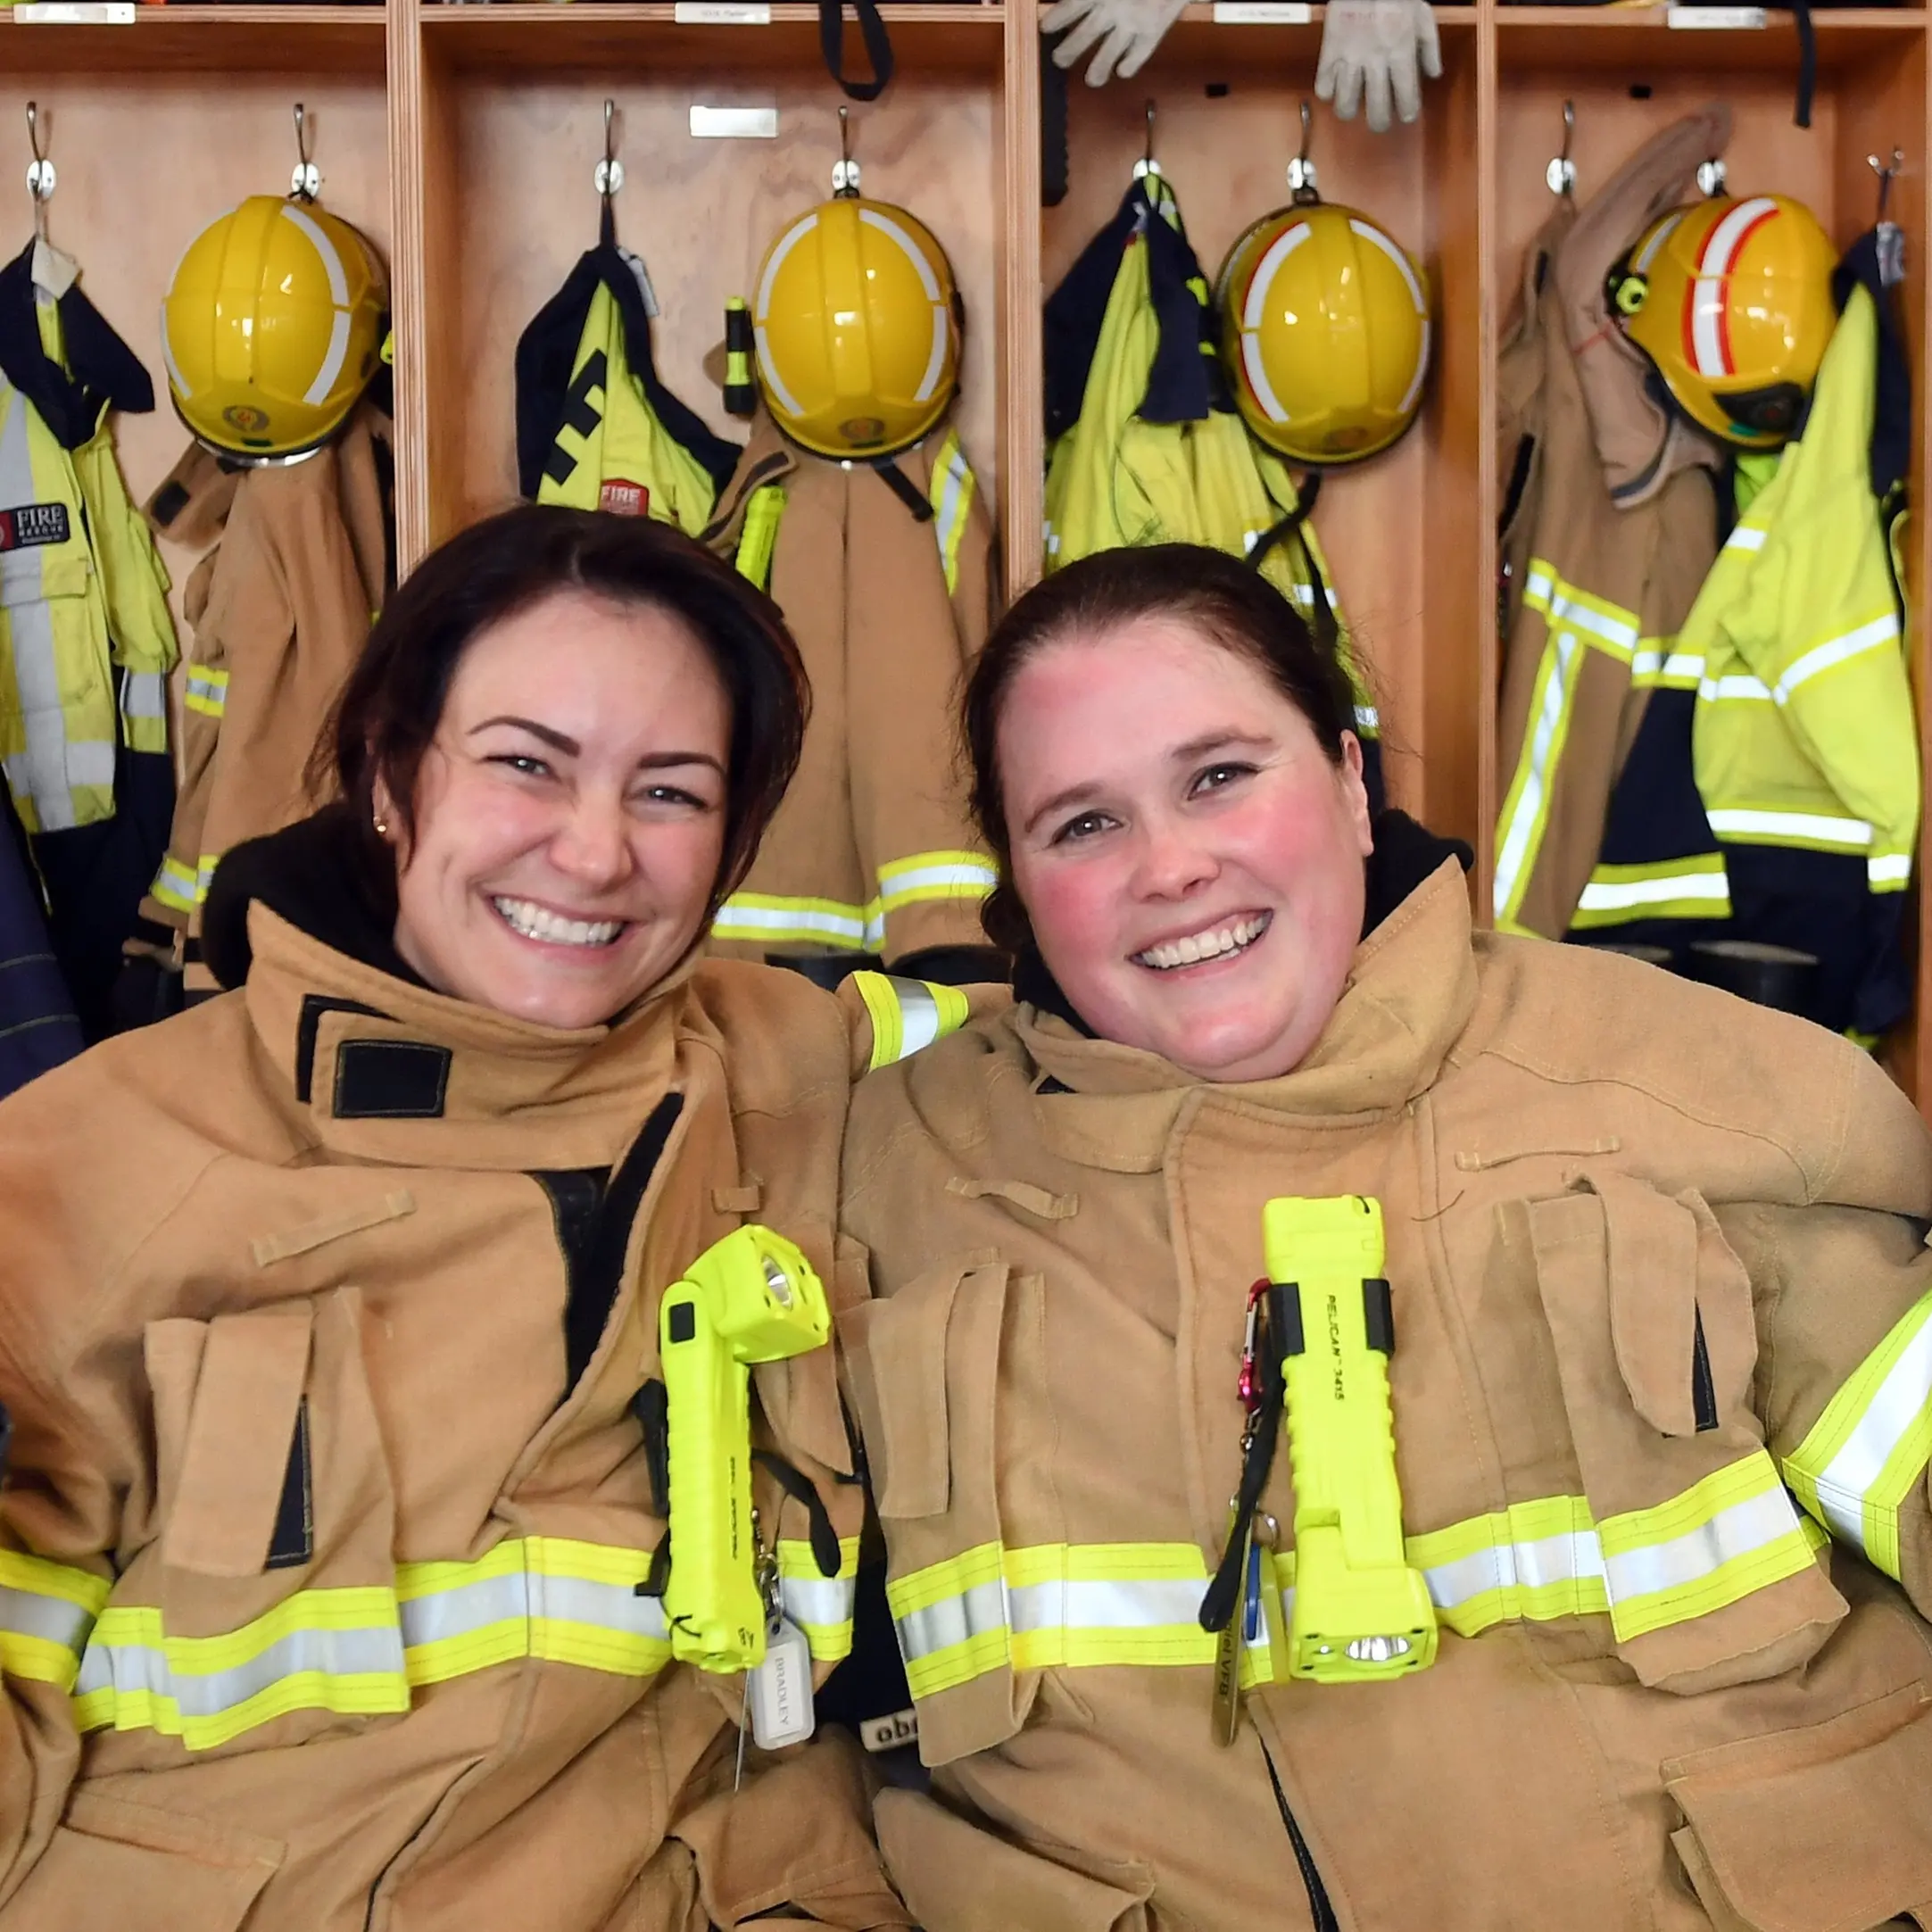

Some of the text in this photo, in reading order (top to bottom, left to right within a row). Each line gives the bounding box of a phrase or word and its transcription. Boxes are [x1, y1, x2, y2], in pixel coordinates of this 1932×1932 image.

[601, 485, 641, 502] FIRE
[17, 506, 63, 528] FIRE
[775, 1657, 790, 1726] BRADLEY
